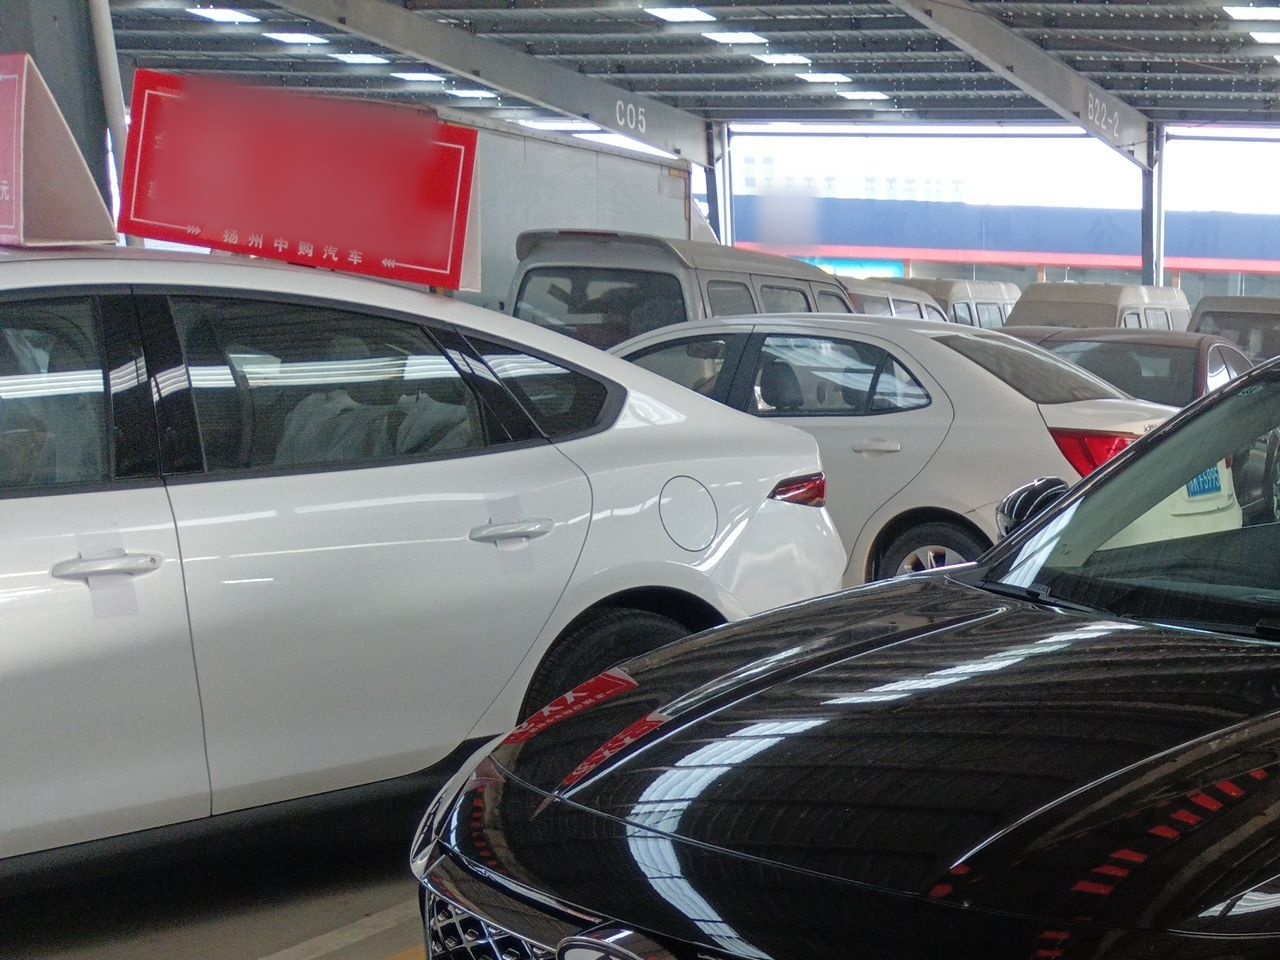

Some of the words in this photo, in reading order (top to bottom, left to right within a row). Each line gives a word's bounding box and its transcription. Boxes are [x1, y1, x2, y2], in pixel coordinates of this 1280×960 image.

[1088, 91, 1119, 137] B22-2
[223, 228, 363, 265] 扬州中购汽车
